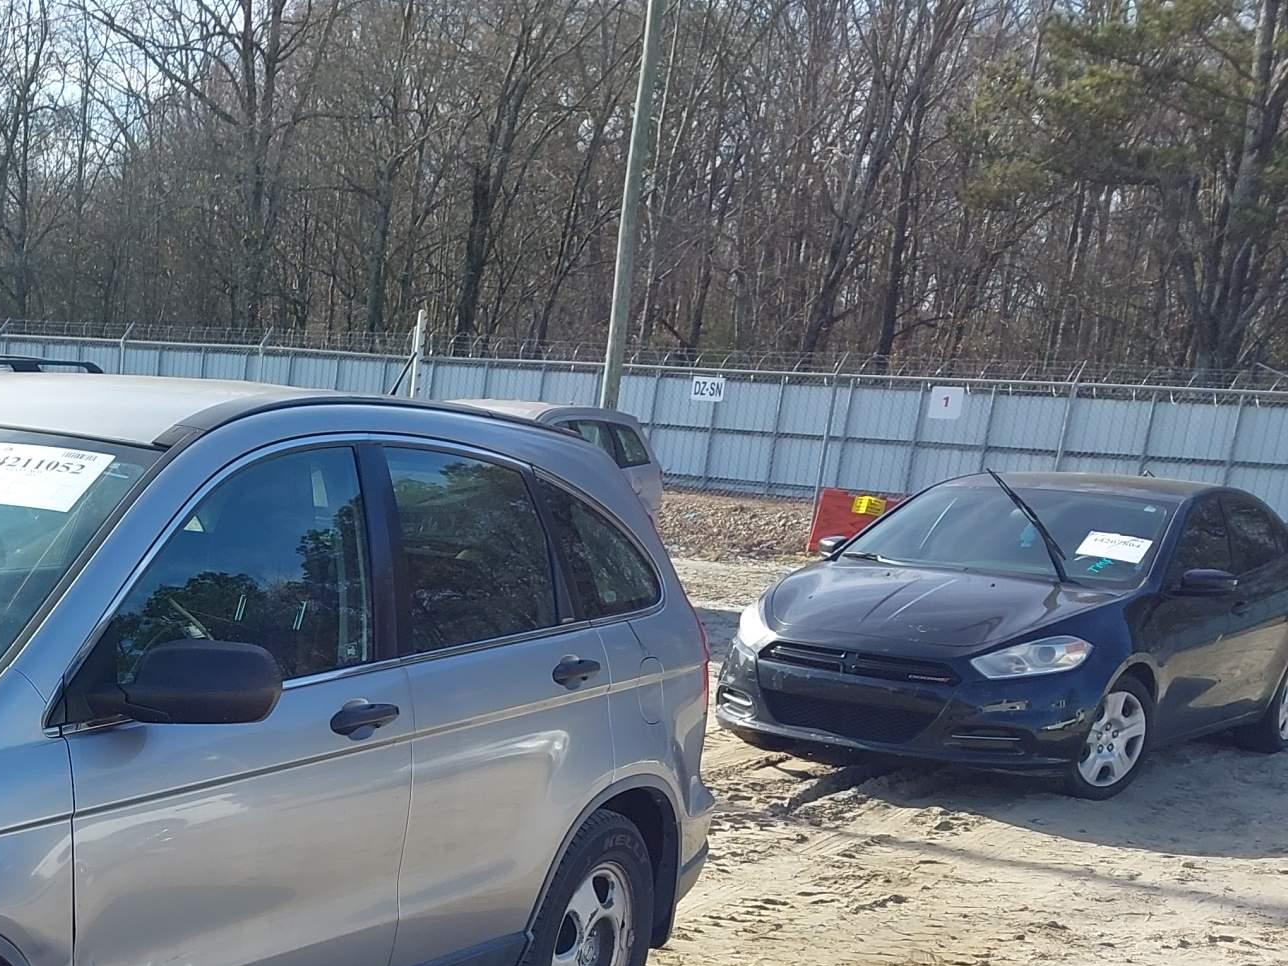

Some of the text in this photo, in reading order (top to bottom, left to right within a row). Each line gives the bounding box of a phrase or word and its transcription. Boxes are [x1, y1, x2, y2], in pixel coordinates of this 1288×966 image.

[693, 381, 724, 397] DZ-SN
[943, 396, 950, 408] 1
[603, 833, 648, 863] KELLY
